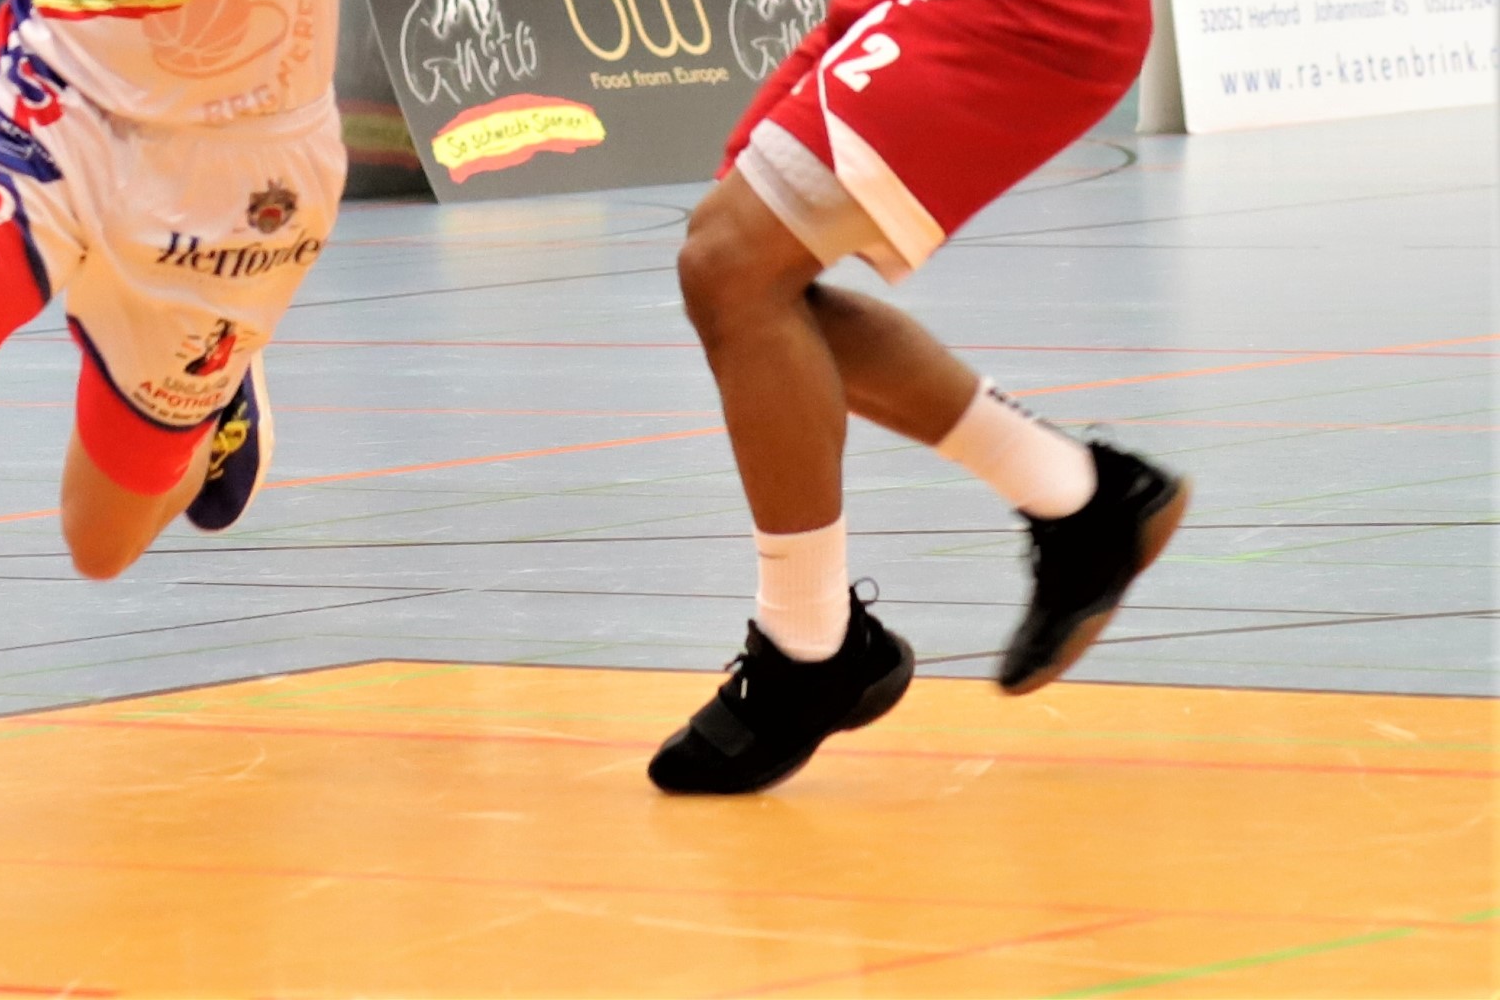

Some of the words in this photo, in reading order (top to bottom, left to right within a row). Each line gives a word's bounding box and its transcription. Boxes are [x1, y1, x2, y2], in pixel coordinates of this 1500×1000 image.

[590, 71, 632, 90] Food
[633, 69, 673, 87] from
[673, 65, 730, 86] Europe
[446, 136, 468, 159] So
